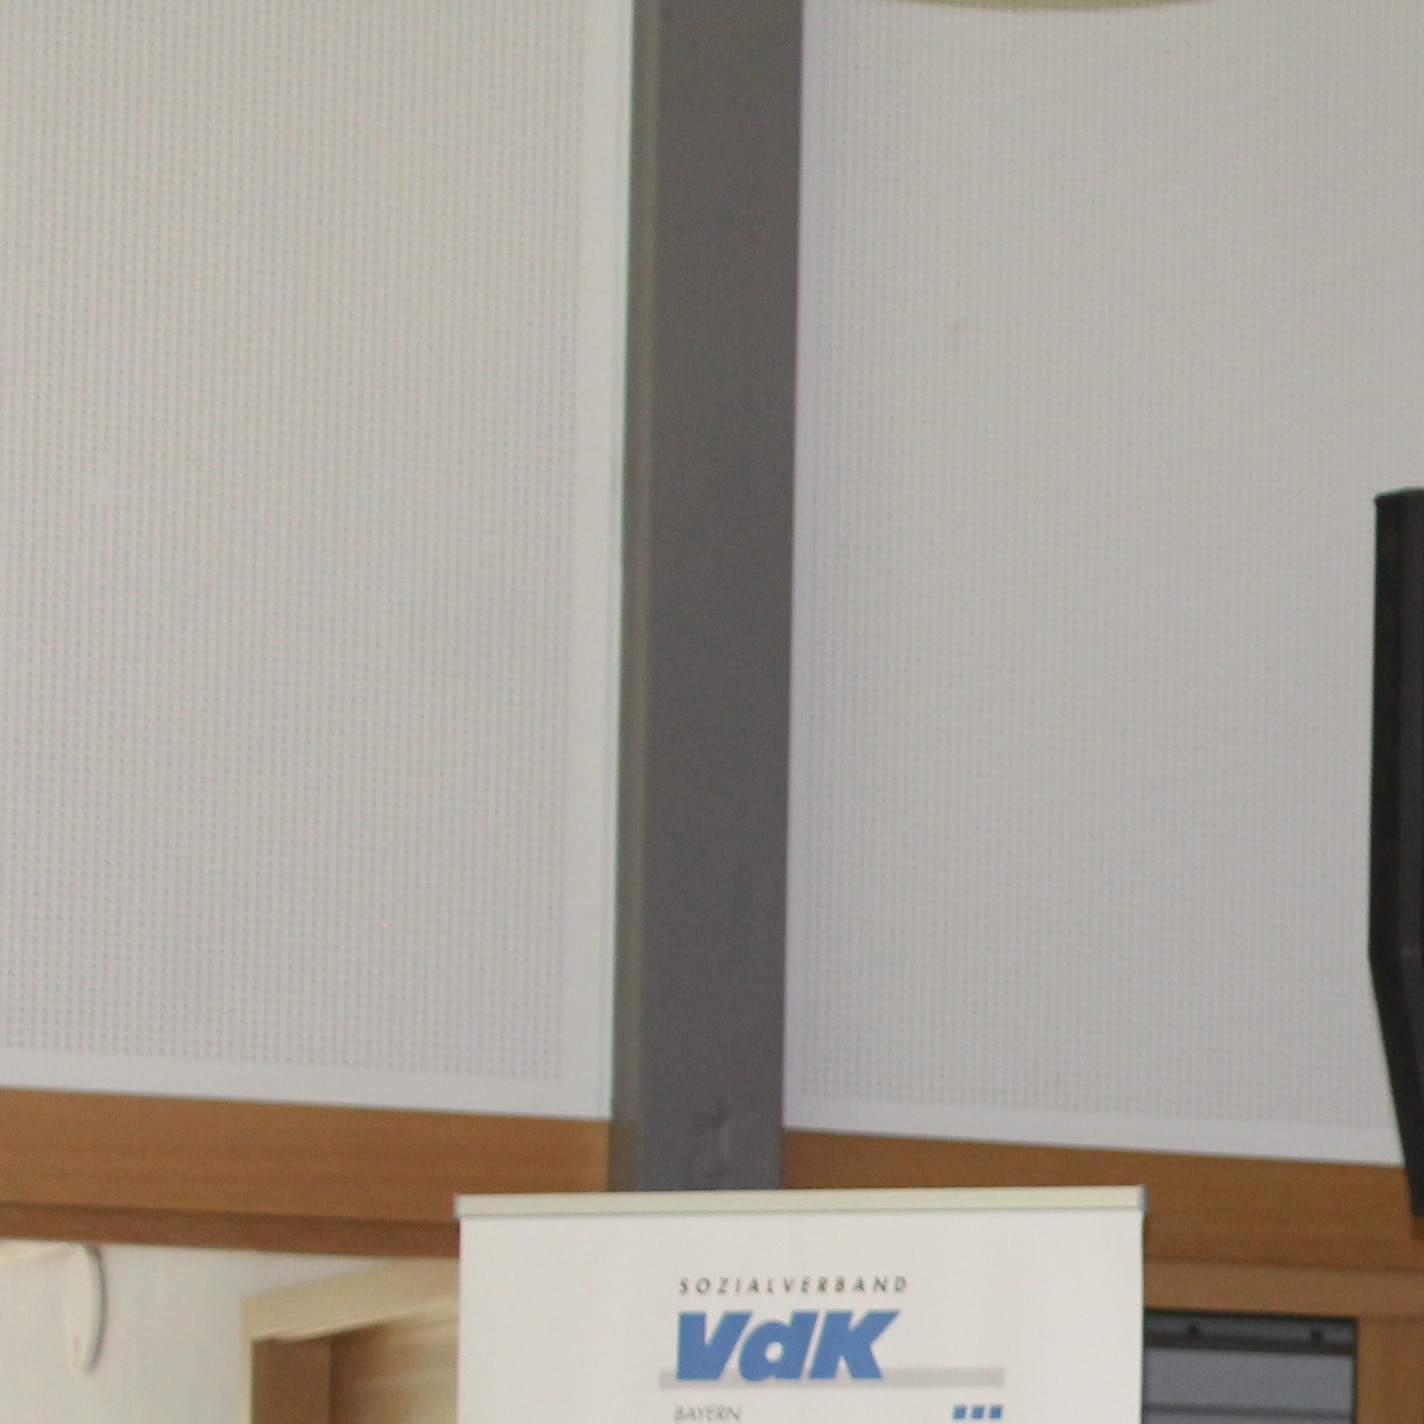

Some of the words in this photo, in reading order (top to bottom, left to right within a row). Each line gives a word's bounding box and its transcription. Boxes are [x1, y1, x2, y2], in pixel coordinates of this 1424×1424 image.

[678, 1275, 908, 1297] SOZIALVERBAND
[674, 1309, 901, 1384] VdK
[673, 1404, 741, 1422] BAYERN
